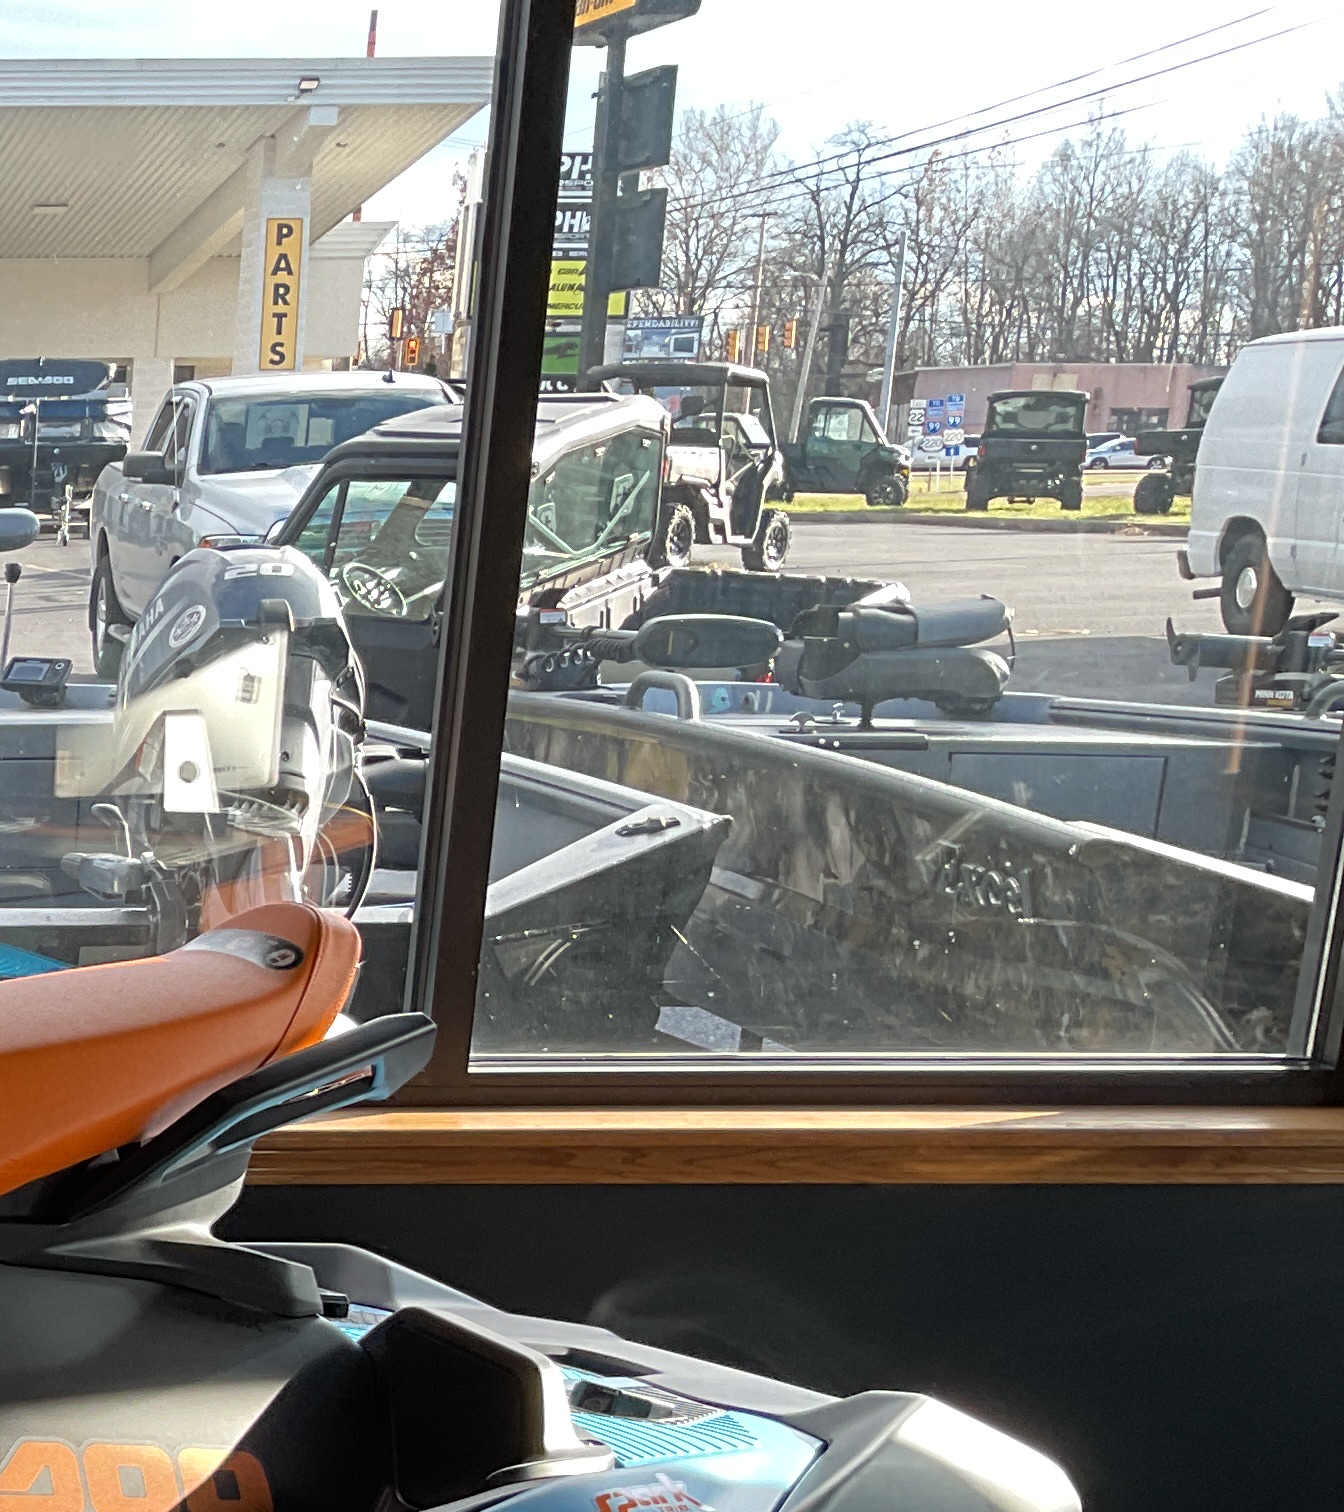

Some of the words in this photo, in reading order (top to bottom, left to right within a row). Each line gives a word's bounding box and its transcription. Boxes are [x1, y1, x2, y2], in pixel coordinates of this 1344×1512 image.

[269, 223, 294, 365] PARTS
[910, 412, 923, 422] 22
[948, 416, 961, 425] 99
[928, 422, 941, 431] 99
[224, 563, 295, 580] 20
